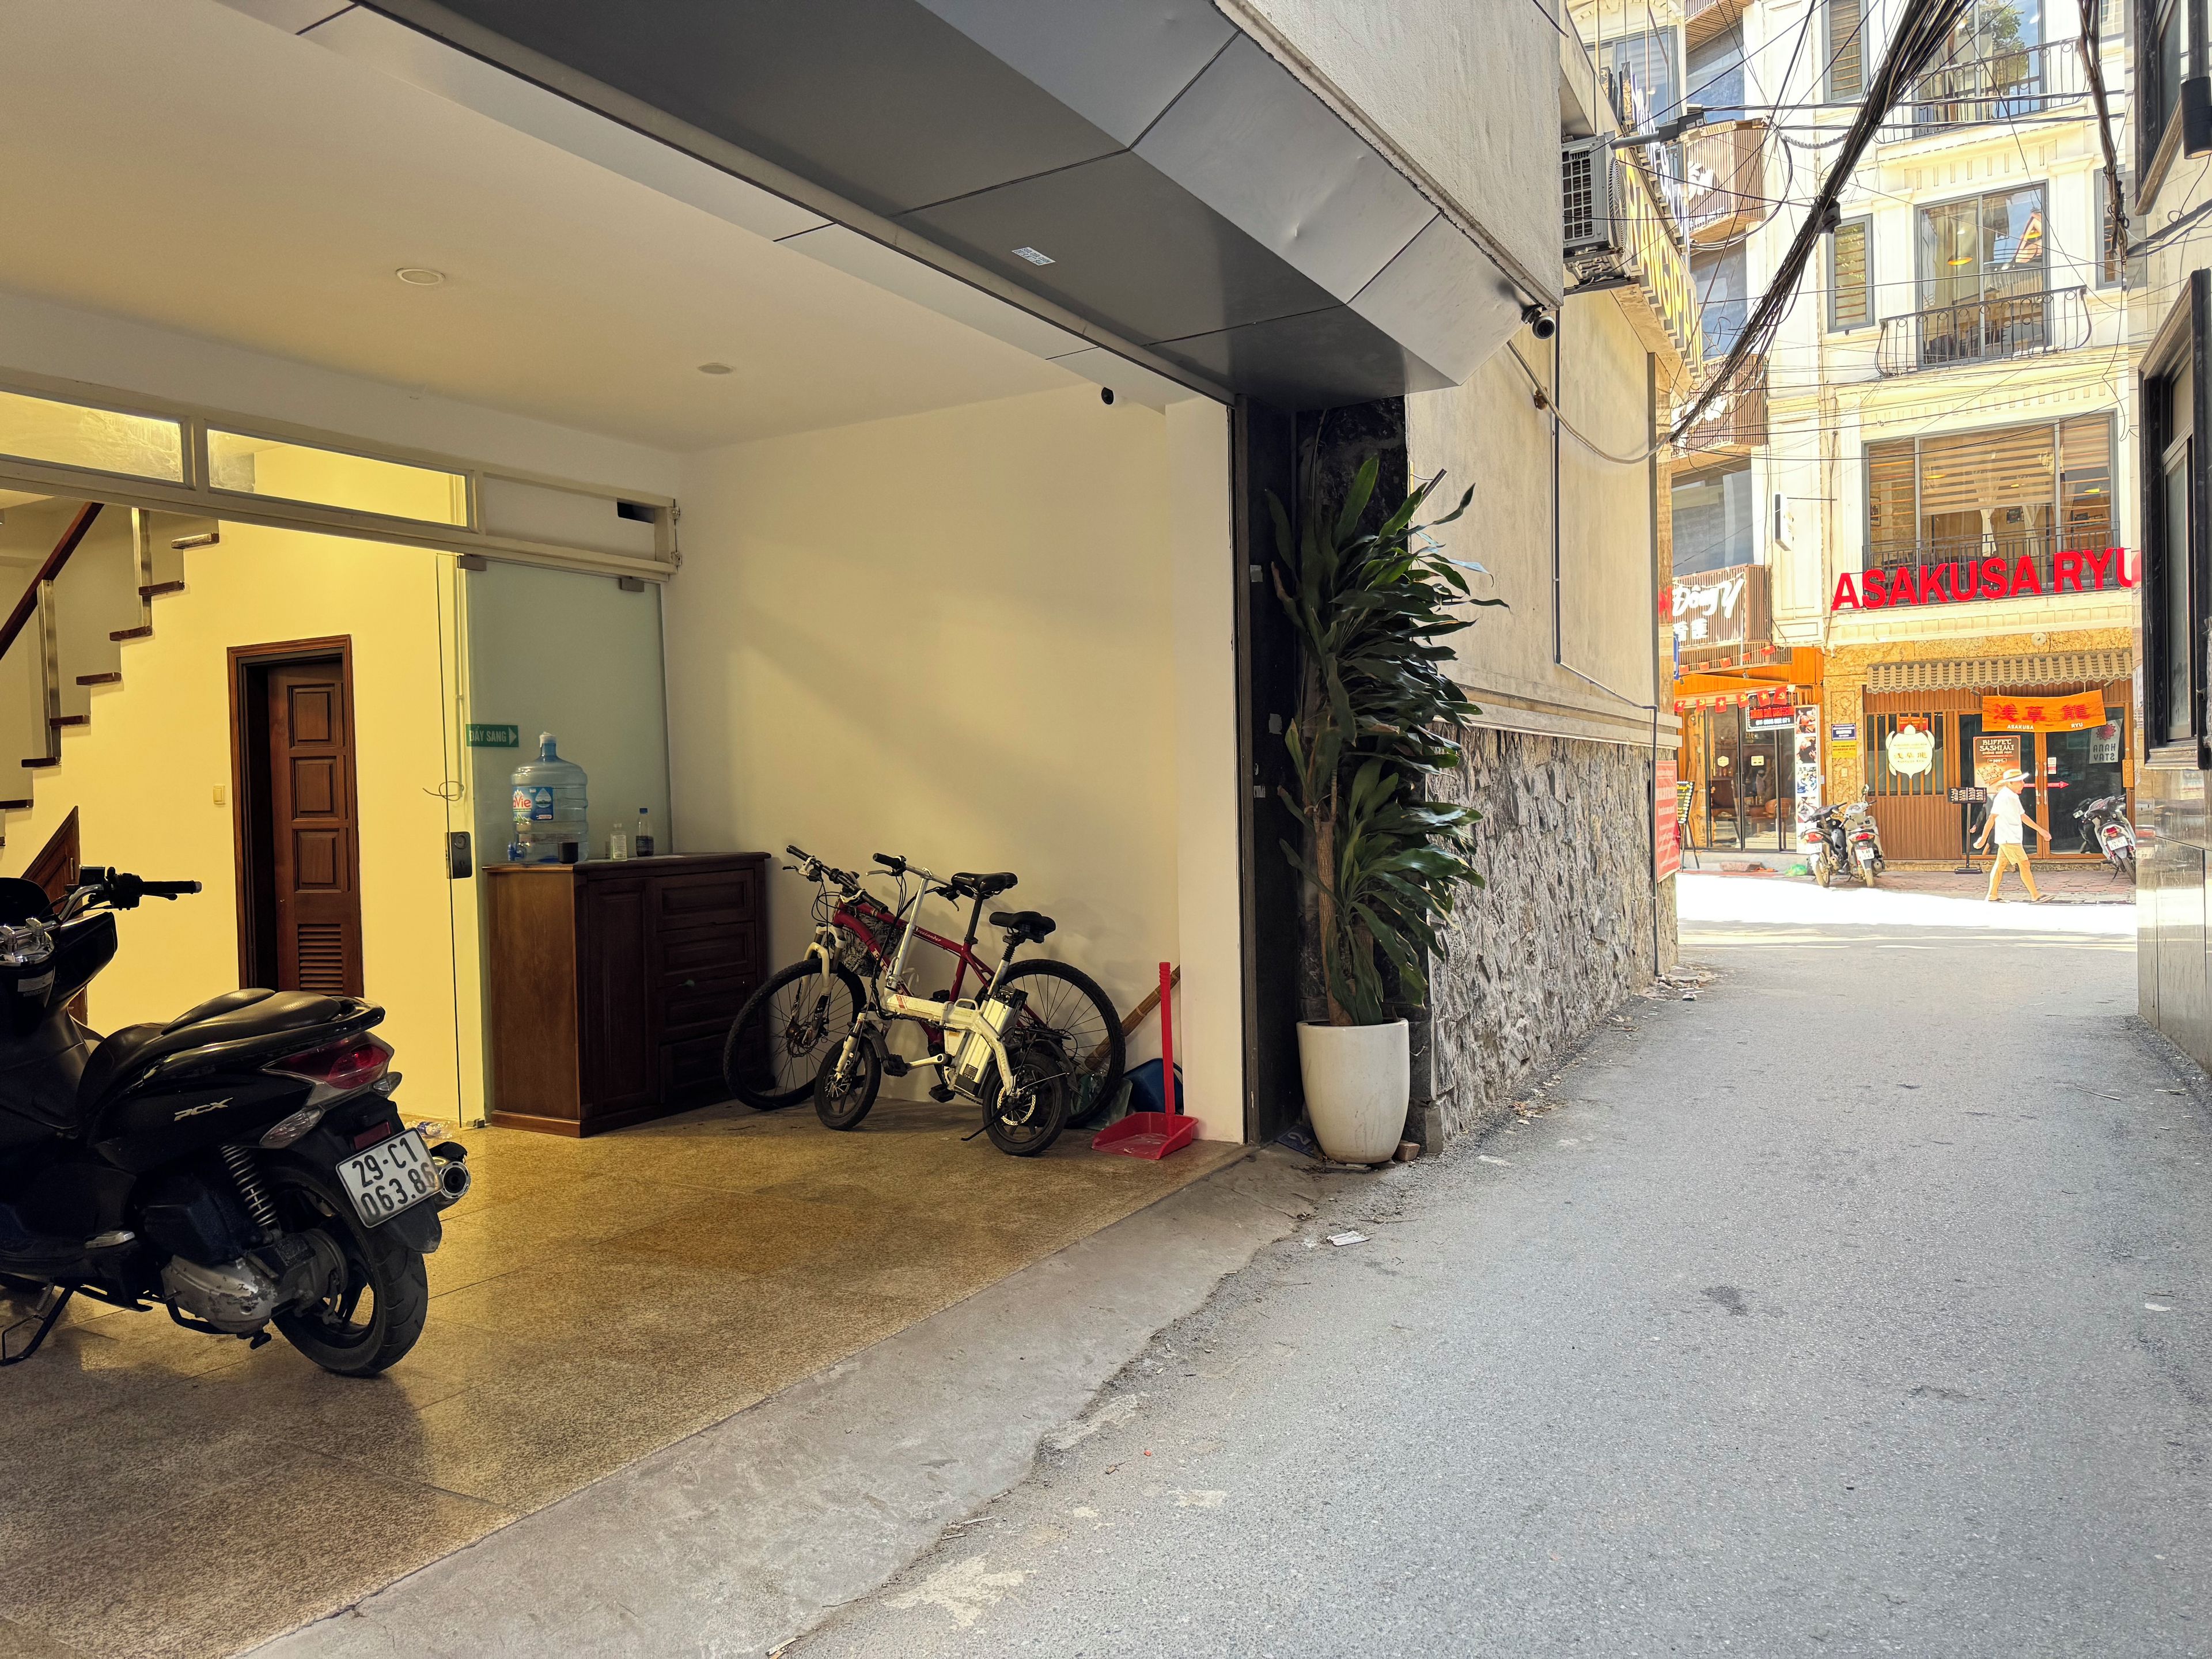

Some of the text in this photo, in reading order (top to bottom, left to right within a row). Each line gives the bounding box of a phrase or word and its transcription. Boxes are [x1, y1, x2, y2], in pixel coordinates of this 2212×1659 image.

[1659, 143, 1690, 253] SALON
[1831, 555, 2042, 611] ASAKUSA
[486, 730, 506, 743] SANG
[174, 1097, 234, 1122] PCX
[352, 1137, 418, 1188] 29-C1
[361, 1162, 435, 1219] 063.86
